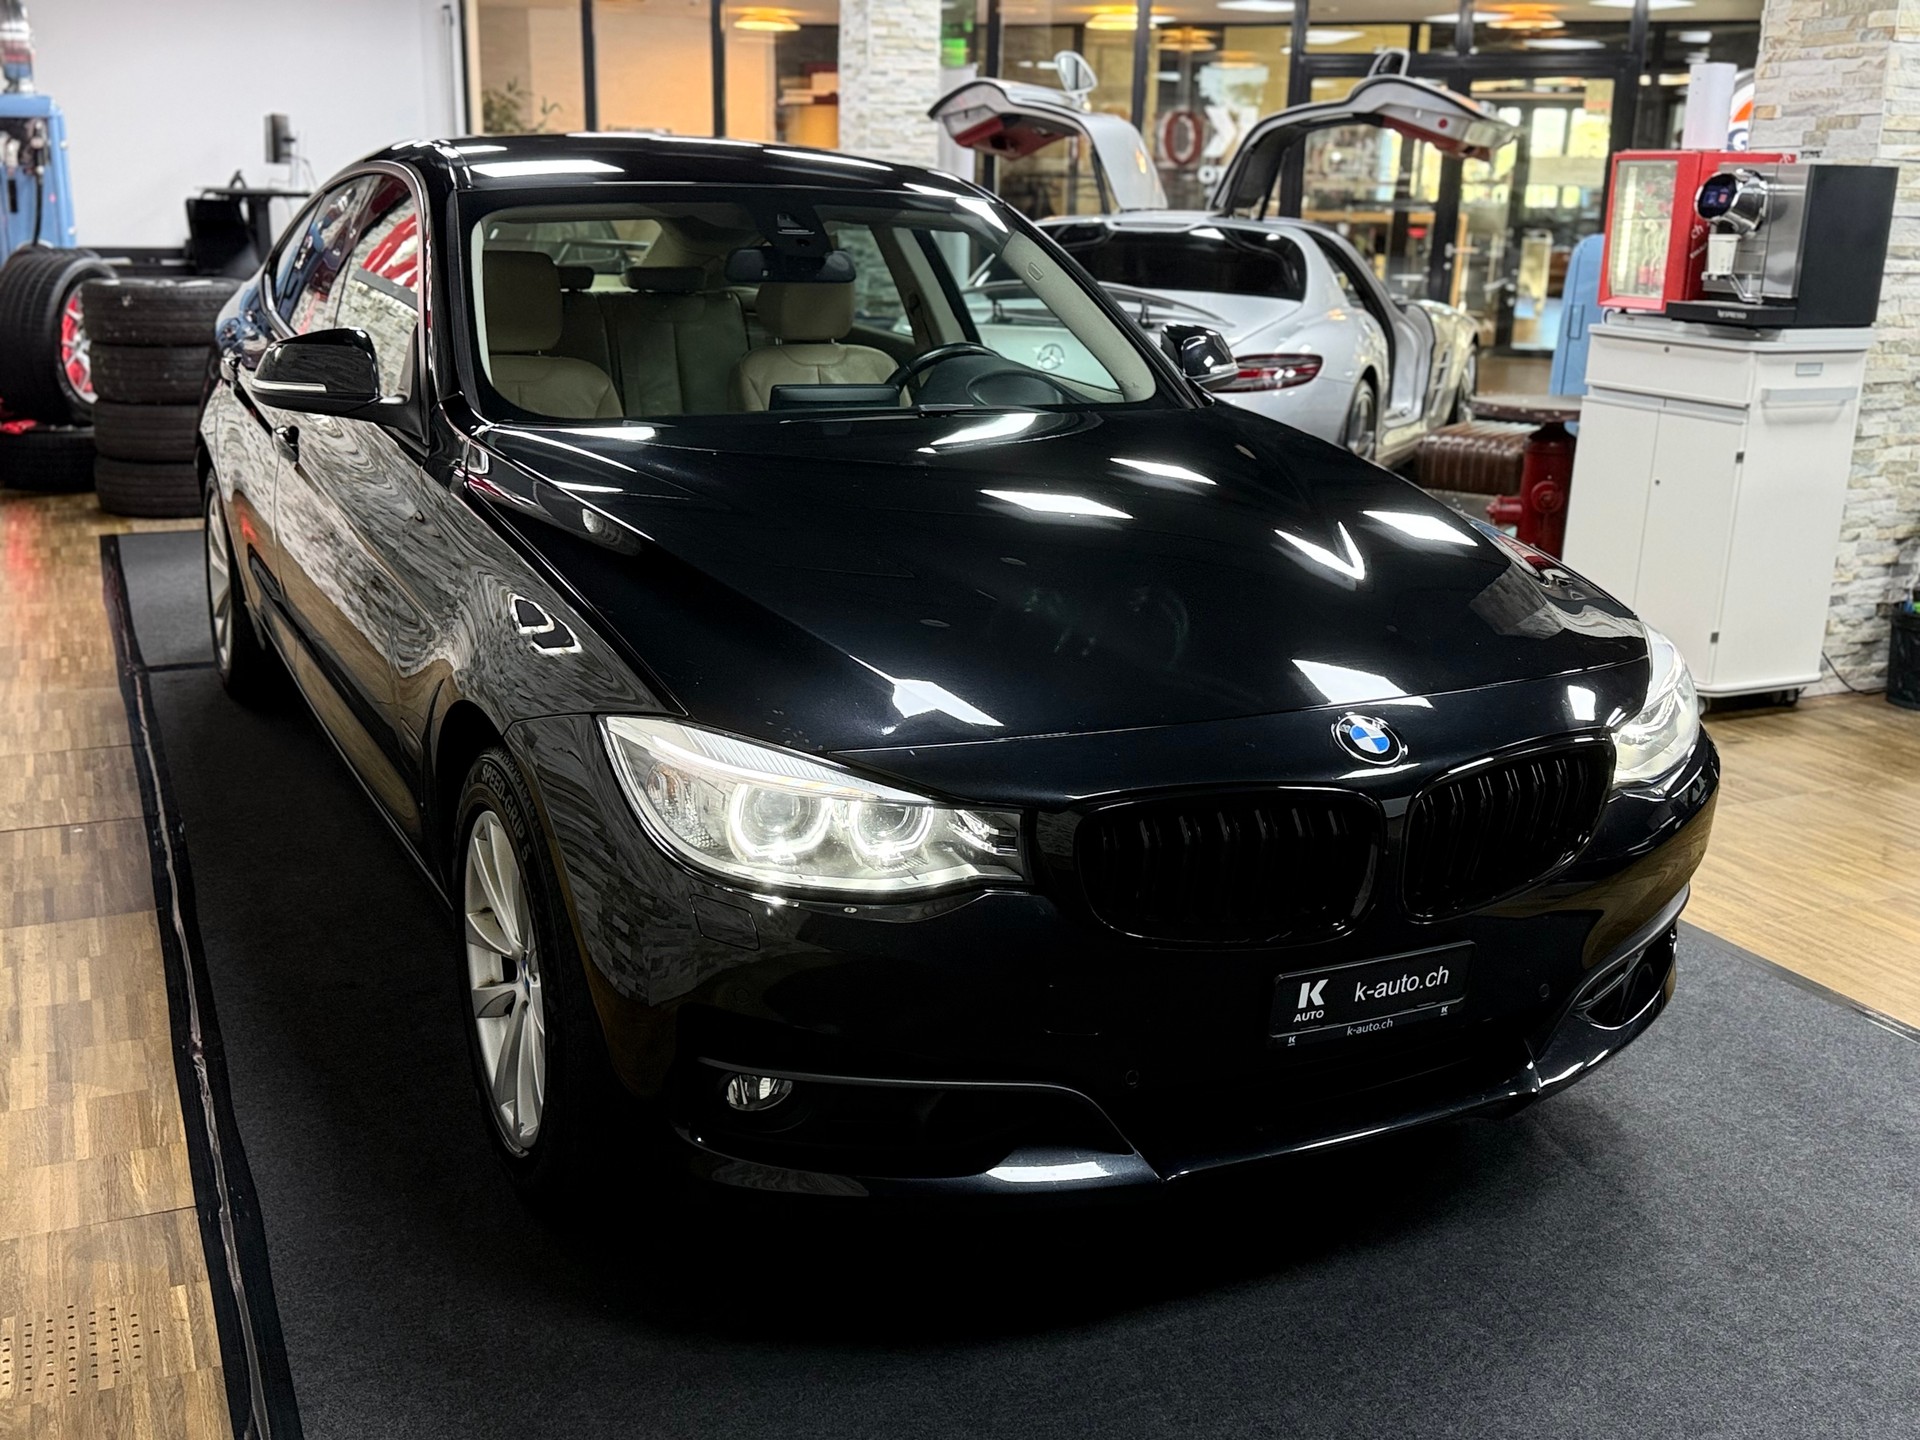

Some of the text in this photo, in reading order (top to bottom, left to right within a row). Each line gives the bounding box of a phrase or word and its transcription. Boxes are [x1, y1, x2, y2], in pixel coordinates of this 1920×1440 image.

[521, 843, 533, 862] 5
[1354, 965, 1450, 1002] k-auto.ch
[1297, 978, 1329, 1009] K
[1293, 1009, 1325, 1023] AUTO
[1346, 1018, 1394, 1036] k-auto.ch
